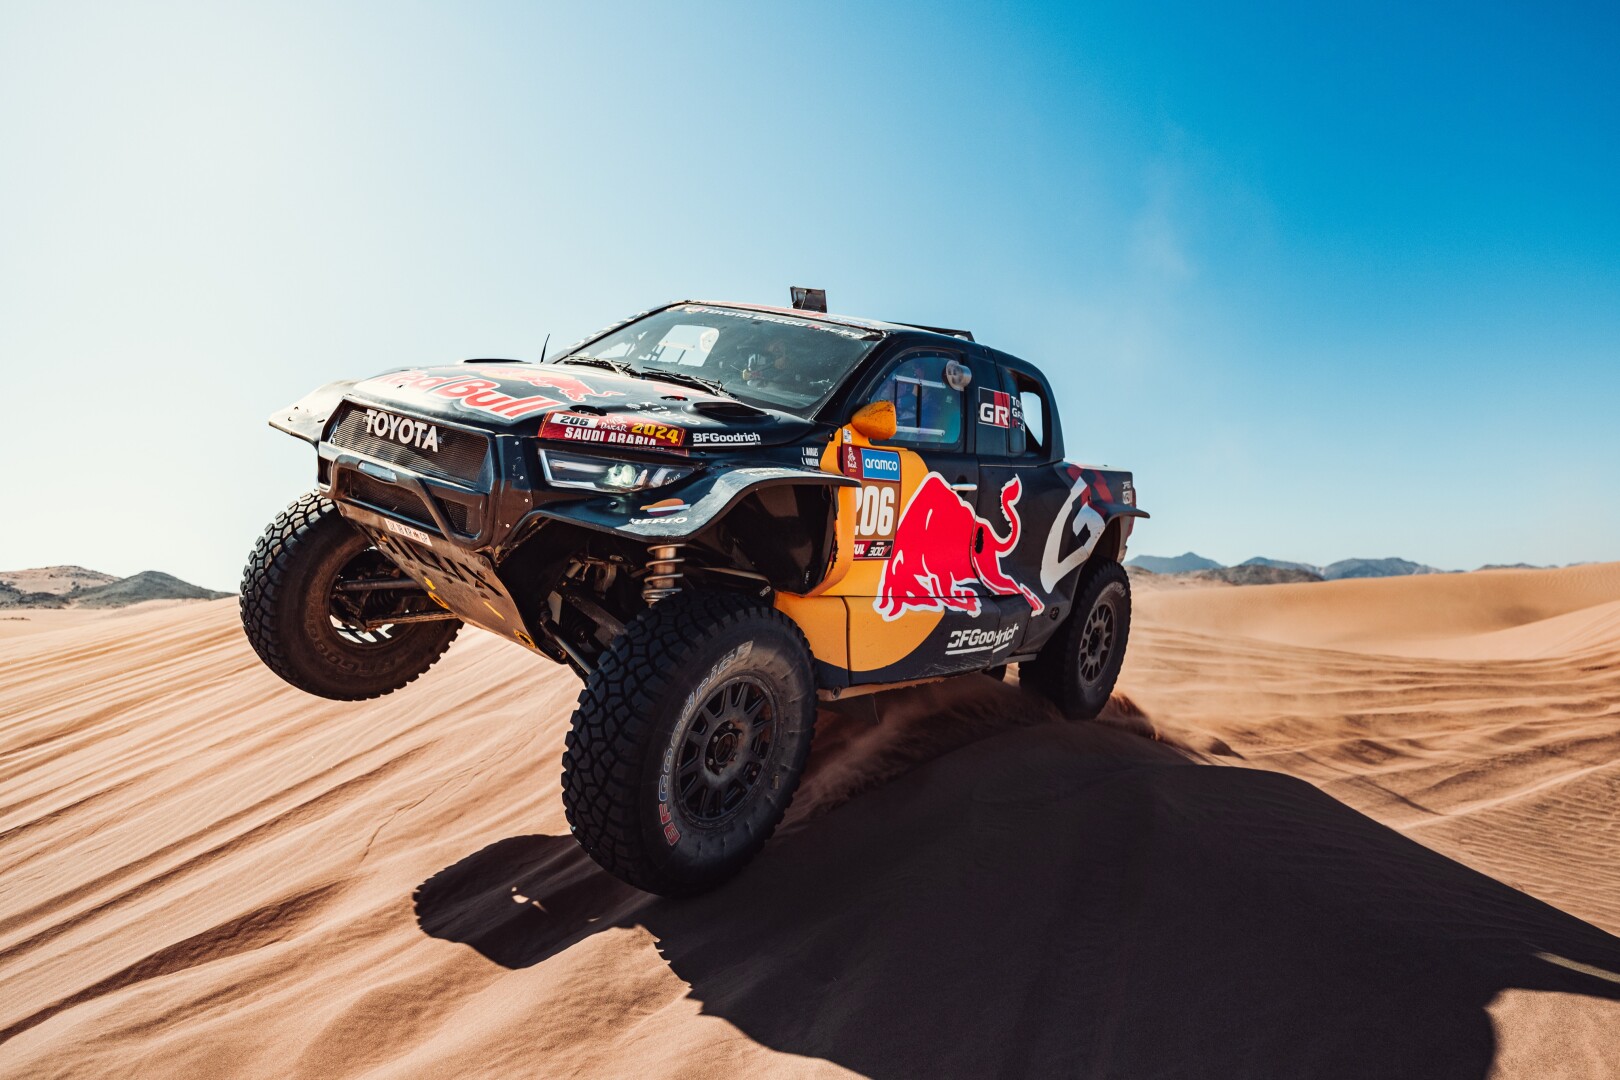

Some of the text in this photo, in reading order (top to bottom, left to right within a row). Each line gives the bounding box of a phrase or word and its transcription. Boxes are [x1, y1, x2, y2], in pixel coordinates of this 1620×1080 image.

[752, 315, 805, 327] GAZOO
[432, 378, 563, 418] Bull
[980, 402, 1009, 426] GR
[364, 409, 438, 452] TOYOTA
[559, 415, 678, 444] 206 DAKAR 2024
[564, 427, 606, 442] SAUDI
[692, 432, 761, 443] BFGoodrich
[864, 458, 898, 471] aramco
